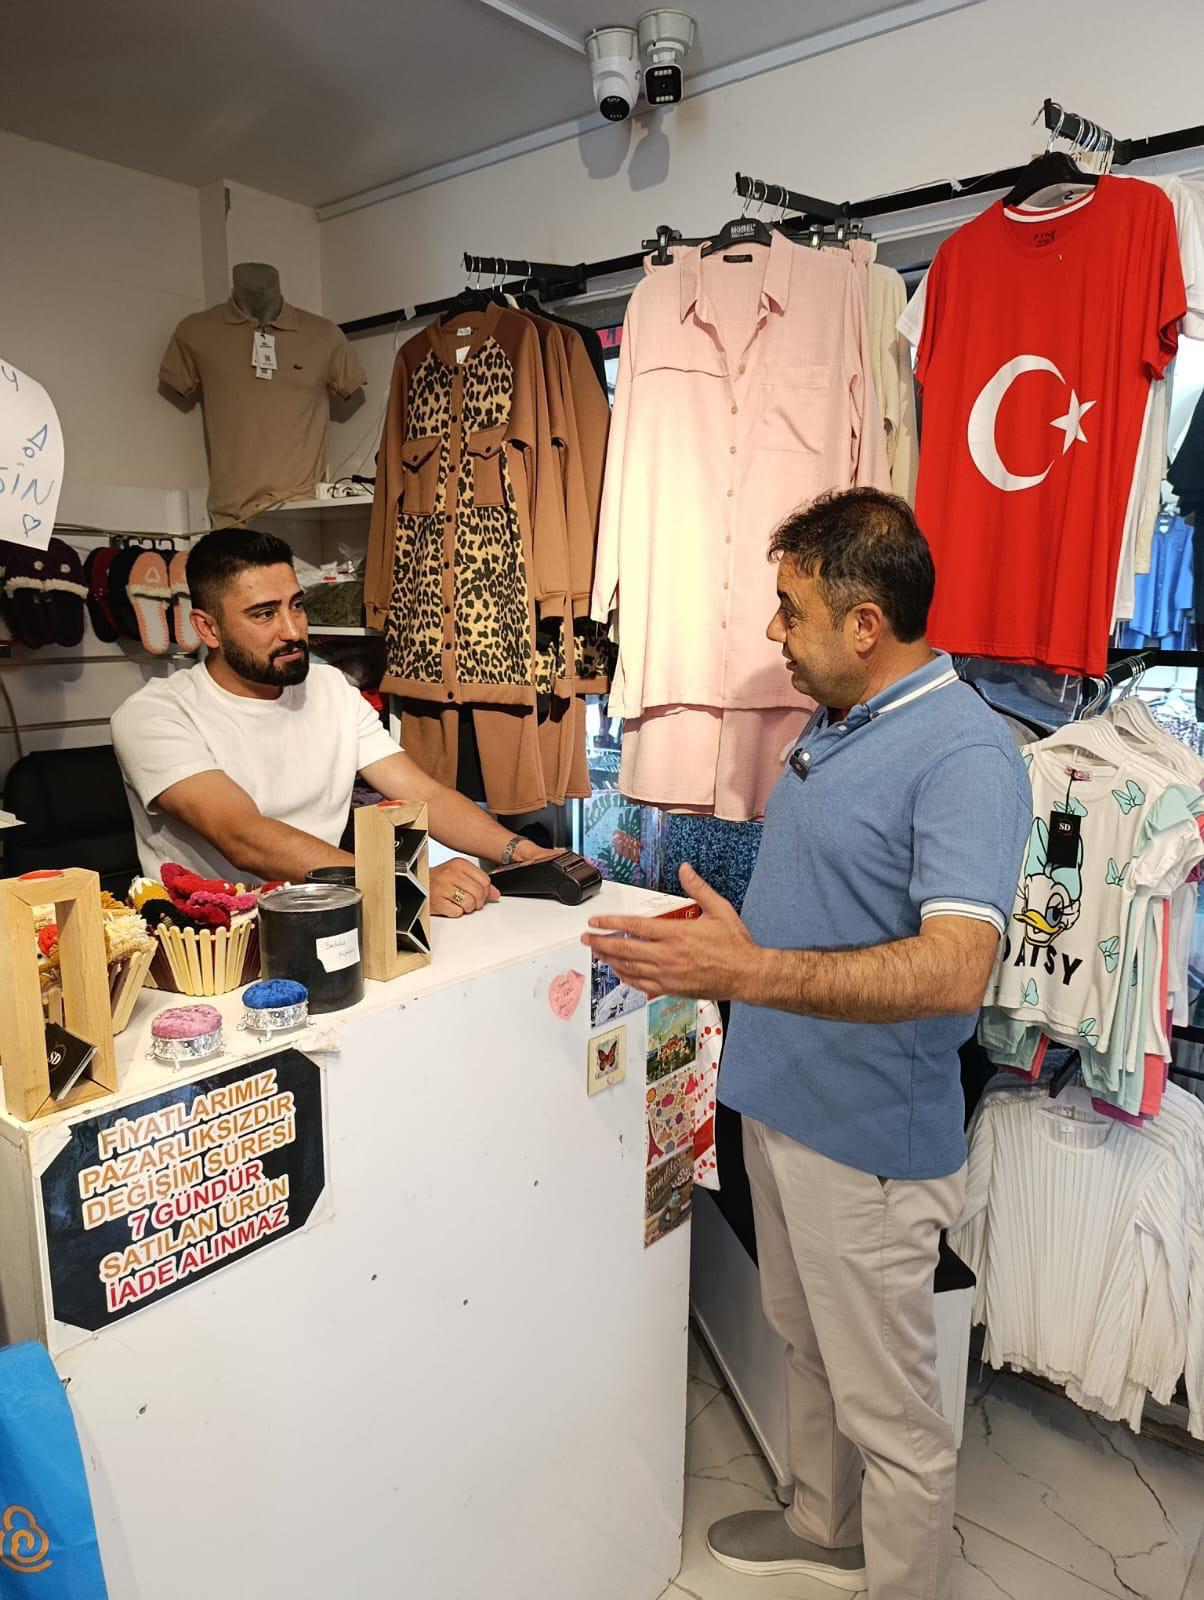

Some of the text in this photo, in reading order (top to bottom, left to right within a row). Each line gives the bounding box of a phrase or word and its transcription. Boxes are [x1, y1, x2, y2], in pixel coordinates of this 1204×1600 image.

[1058, 821, 1071, 832] SD
[81, 1094, 294, 1196] PAZARLIKSIZDIR
[99, 1070, 277, 1158] FİYATLARIMIZ
[84, 1117, 295, 1228] DEĞİŞİM SÜRESİ
[130, 1162, 262, 1237] 7 GÜNDÜR
[102, 1177, 289, 1279] SATILAN ÜRÜN
[107, 1206, 289, 1309] İADE ALINMAZ
